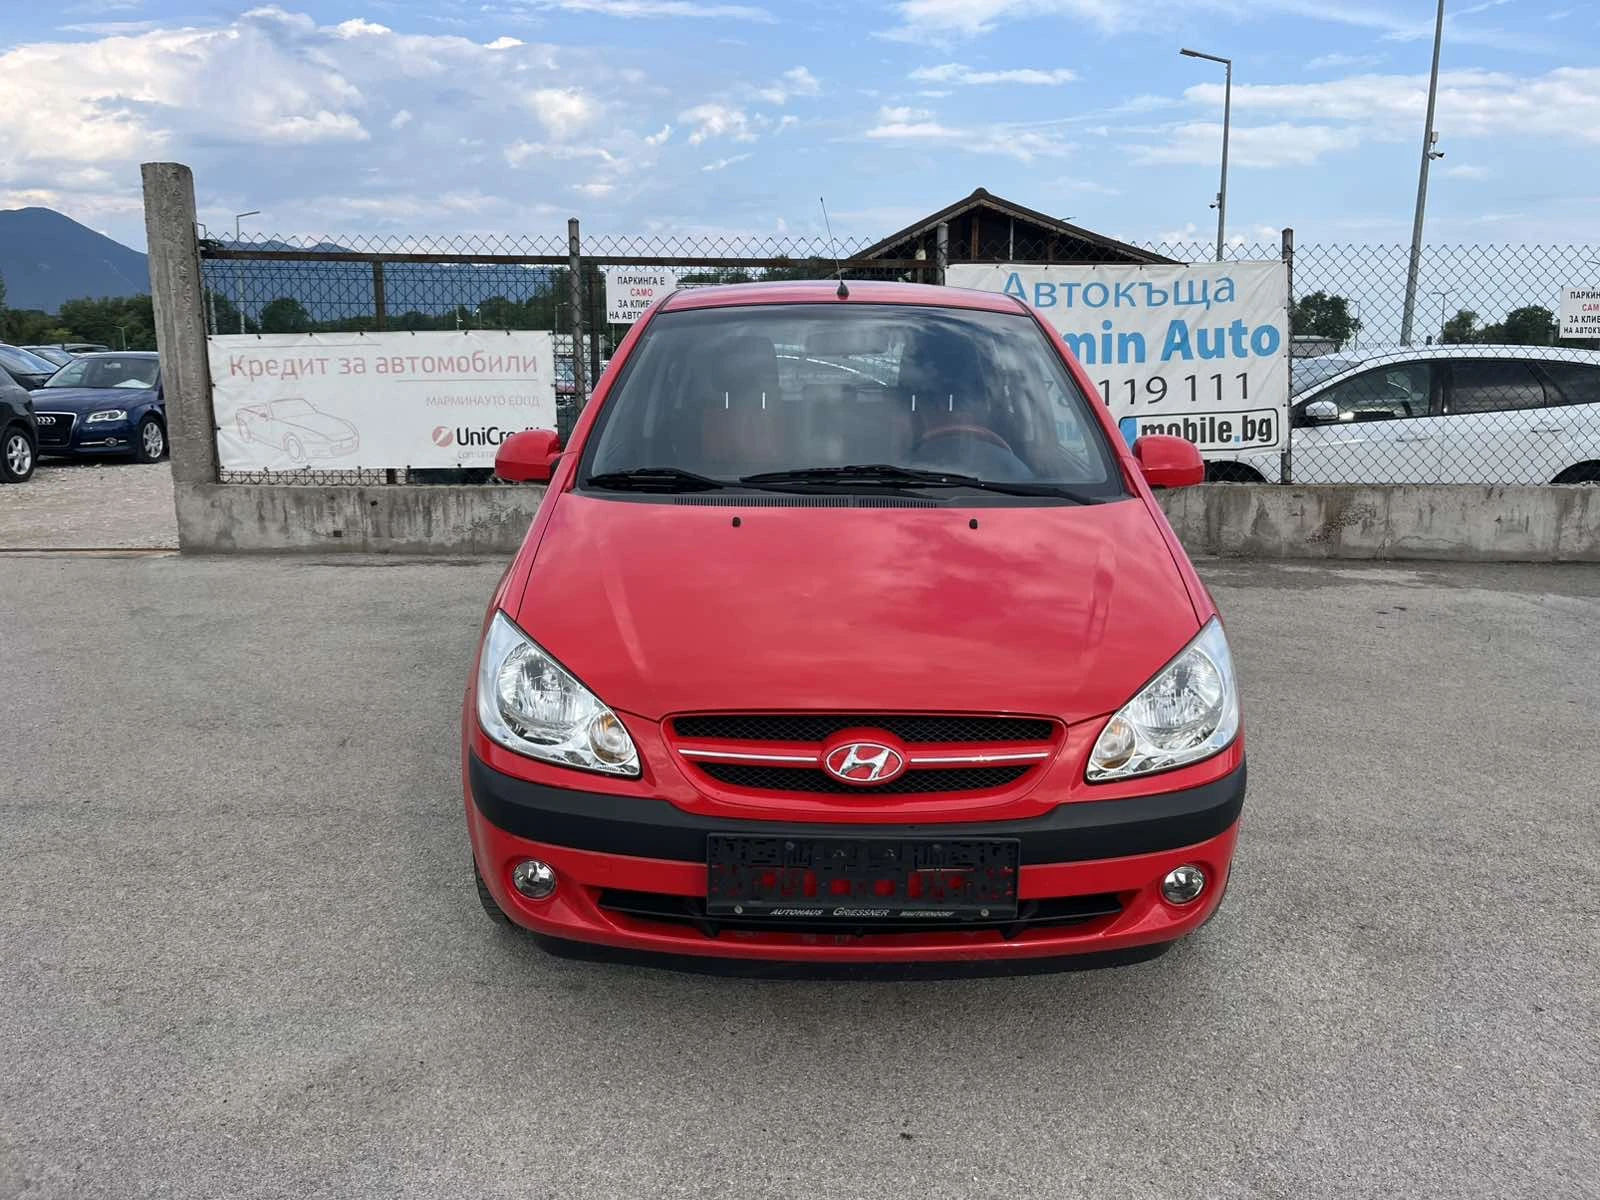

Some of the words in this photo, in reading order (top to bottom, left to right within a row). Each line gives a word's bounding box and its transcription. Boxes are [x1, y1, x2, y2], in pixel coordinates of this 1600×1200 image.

[617, 276, 659, 285] ПАРКИНГА
[660, 276, 665, 286] Е
[630, 288, 654, 297] САМО
[1003, 270, 1235, 310] Автокъща
[617, 300, 629, 308] ЗА
[630, 300, 653, 309] КЛИЕ
[609, 312, 620, 320] НА
[1569, 315, 1579, 323] ЗА
[1160, 318, 1280, 361] Auto
[229, 355, 330, 382] Кредит
[338, 357, 366, 375] за
[375, 350, 538, 374] автомобили
[1185, 372, 1248, 402] 111
[456, 426, 540, 446] UniCr
[1141, 415, 1272, 444] mobile.bg
[769, 908, 824, 916] AUTOHAUS
